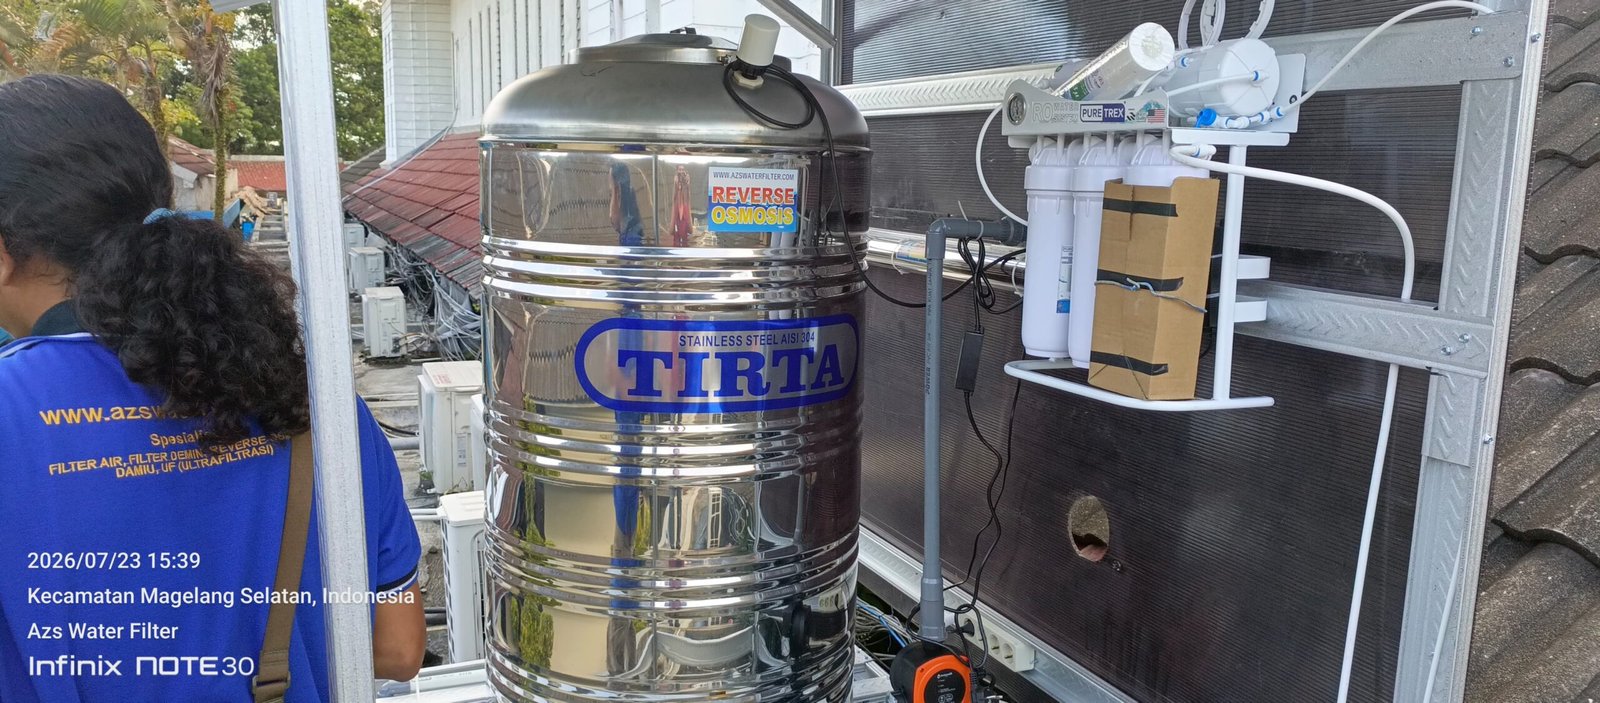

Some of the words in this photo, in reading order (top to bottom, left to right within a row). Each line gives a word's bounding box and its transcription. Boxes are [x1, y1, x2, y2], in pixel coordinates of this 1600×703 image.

[713, 171, 795, 181] WWW.AZSWATERFILTER.COM
[711, 186, 795, 205] REVERSE
[711, 206, 794, 225] OSMOSIS
[679, 334, 743, 347] STAINLESS
[746, 333, 779, 346] STEEL
[781, 332, 800, 344] AISI
[800, 331, 815, 343] 304
[617, 344, 845, 398] TIRTA
[49, 460, 97, 476] FILTER
[100, 456, 127, 468] AIR,
[129, 452, 168, 464] FILTER
[162, 462, 176, 473] UF
[178, 444, 274, 472] (ULTRAFILTRASI)
